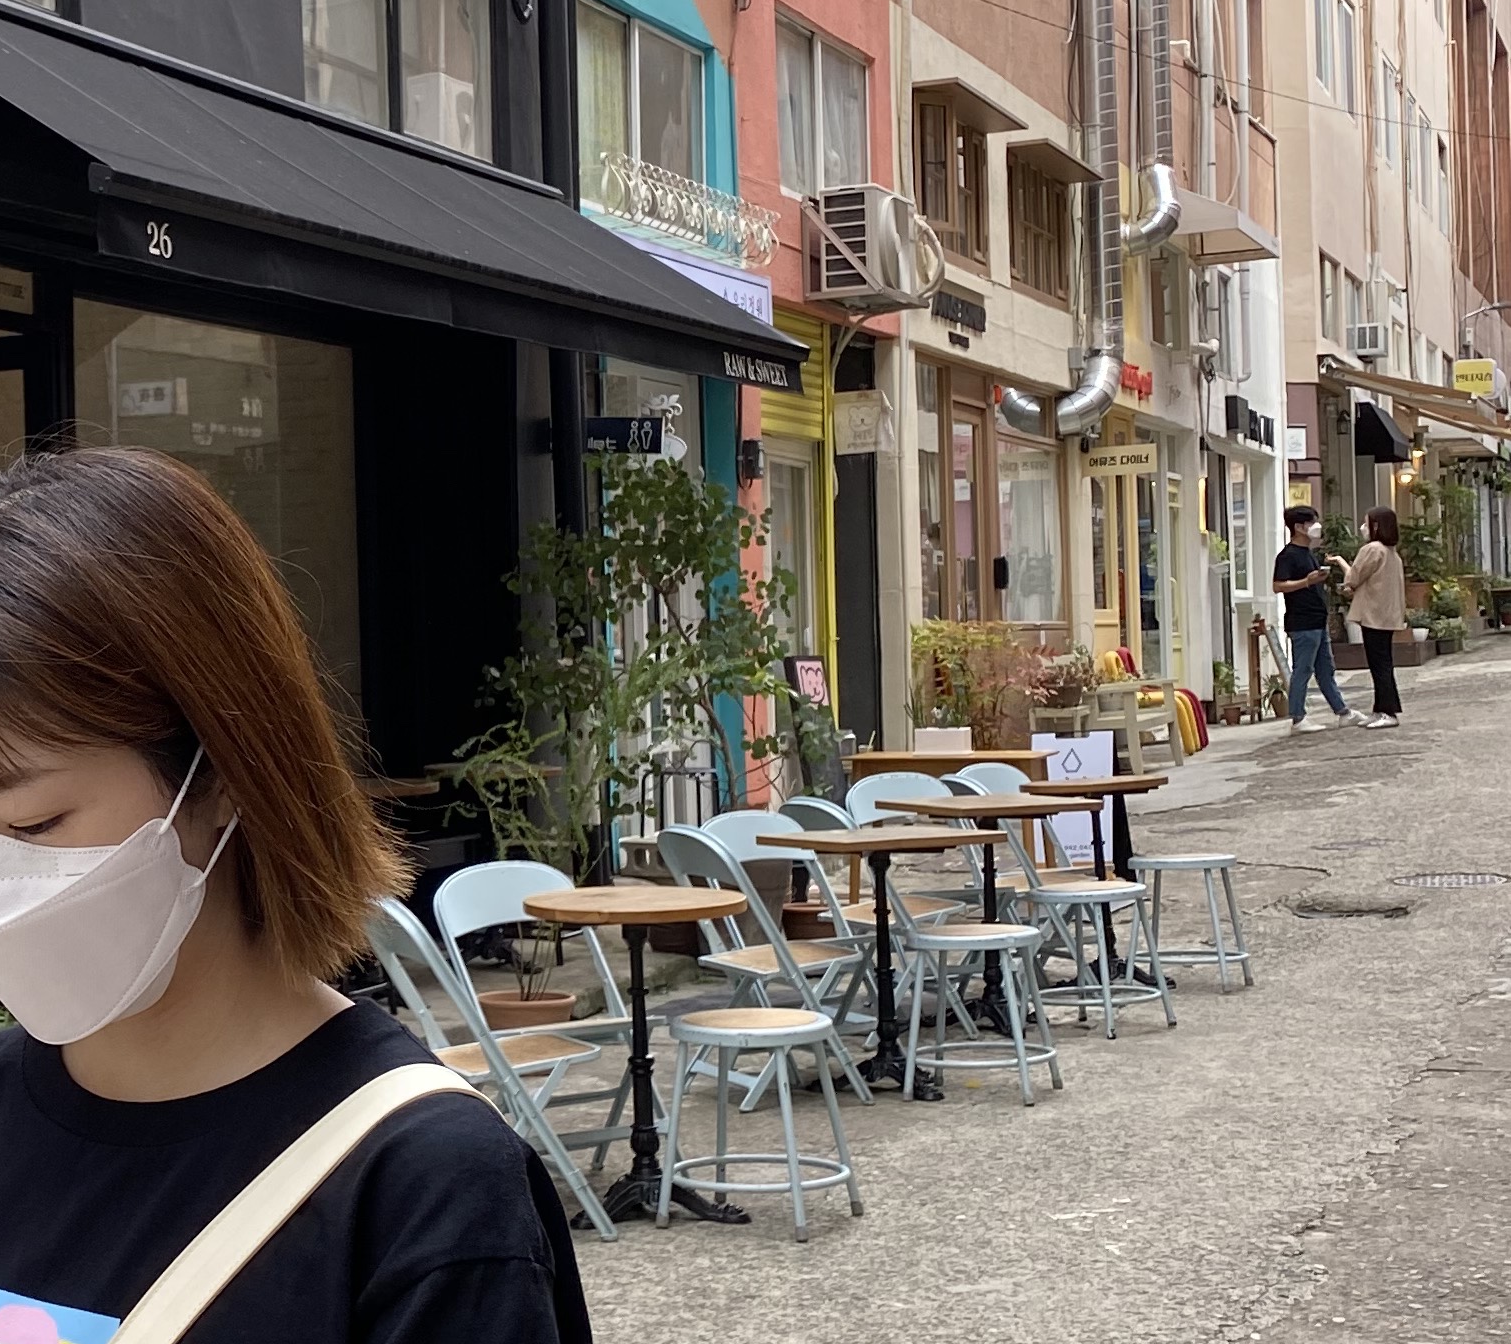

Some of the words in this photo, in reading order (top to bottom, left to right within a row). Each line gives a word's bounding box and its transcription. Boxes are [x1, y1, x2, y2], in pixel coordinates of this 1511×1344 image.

[146, 221, 173, 260] 26
[723, 351, 747, 379] RAW
[747, 356, 757, 381] &
[755, 358, 789, 387] SWEET
